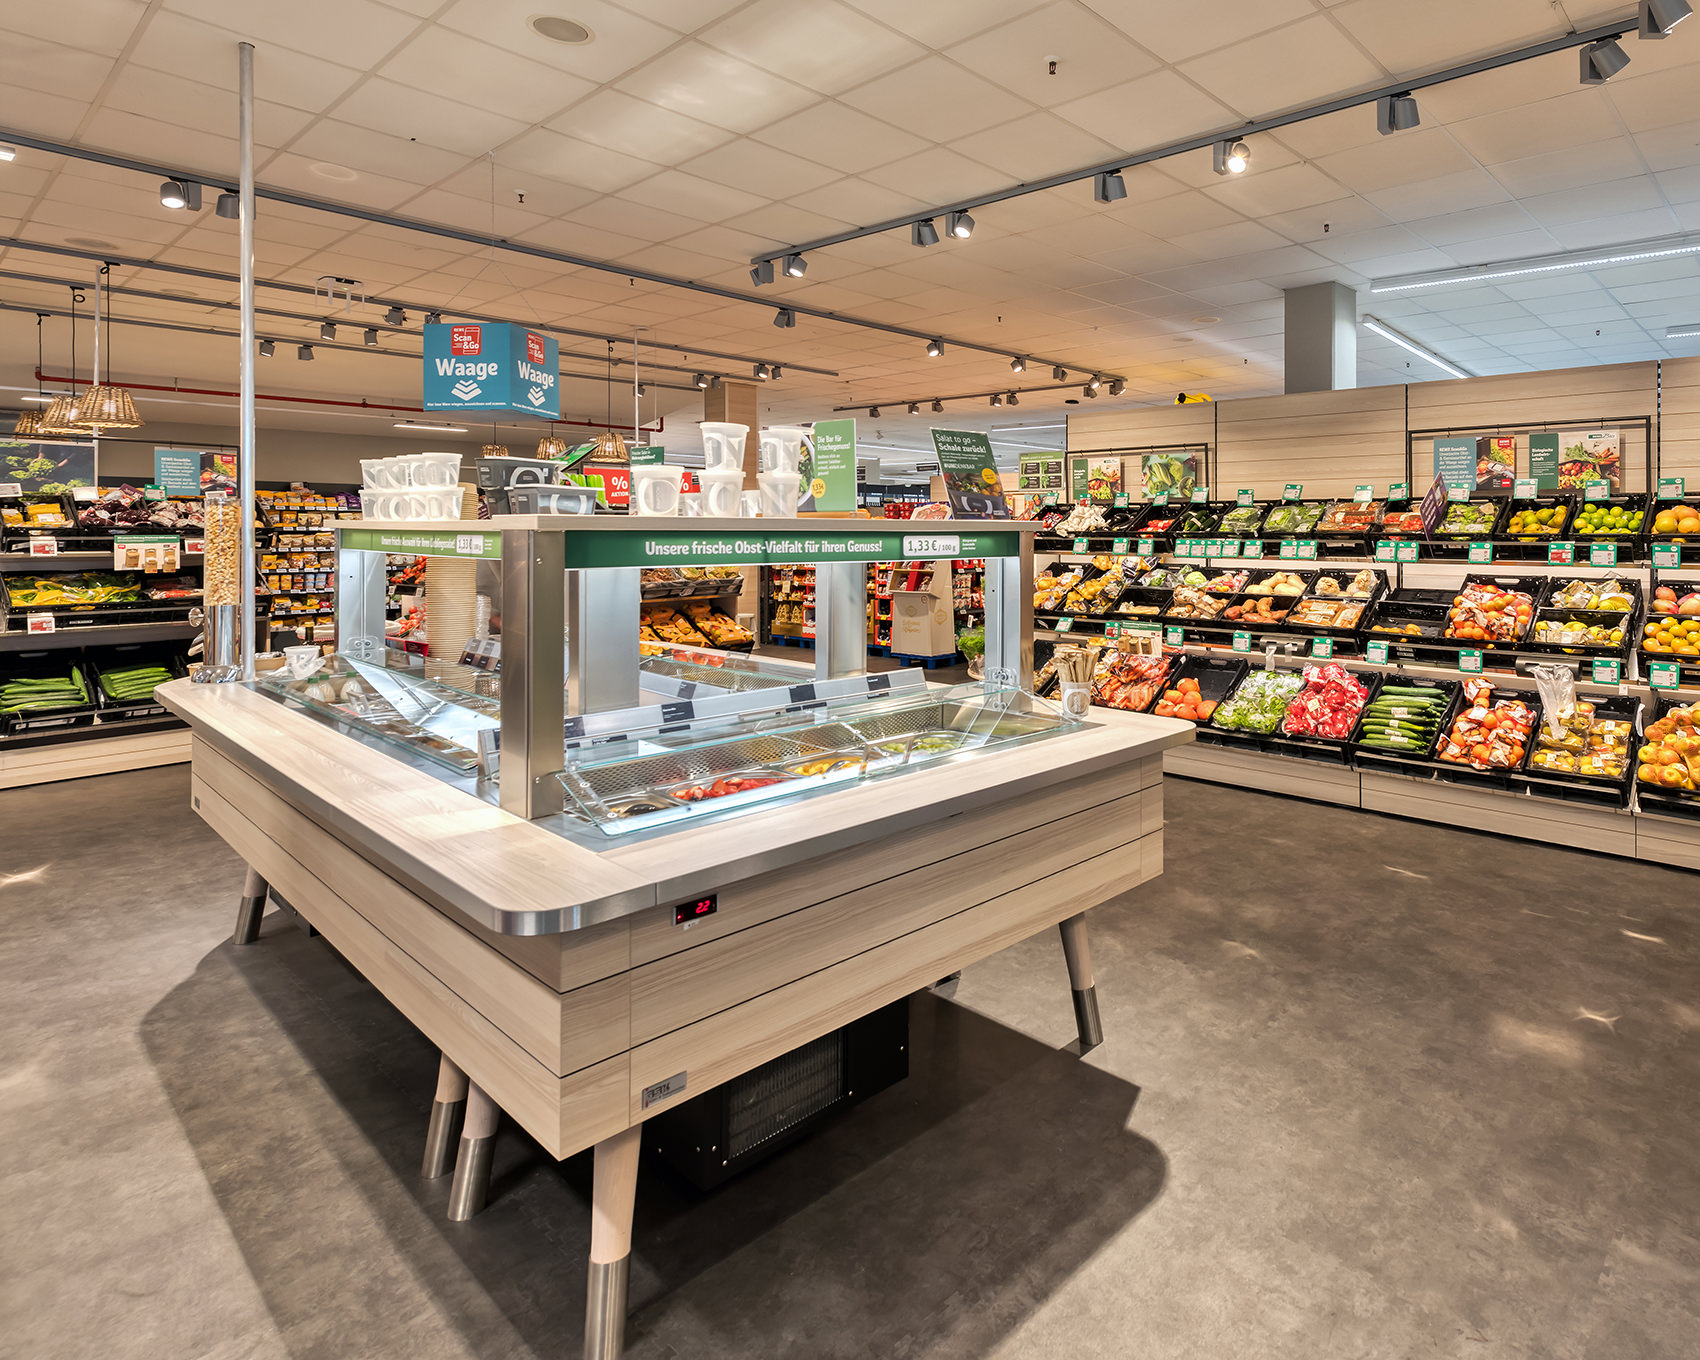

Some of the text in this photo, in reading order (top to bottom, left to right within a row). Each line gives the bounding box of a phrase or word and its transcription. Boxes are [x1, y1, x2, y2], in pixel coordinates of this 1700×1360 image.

[529, 340, 539, 350] Scan
[435, 358, 498, 380] Waage
[518, 360, 555, 390] Waage
[936, 434, 953, 442] Salat
[938, 443, 987, 453] Schale zurück!
[612, 476, 628, 490] %
[645, 540, 883, 556] Unsere frische Obst-Vielfalt für ihren Genuss!
[908, 540, 929, 553] 1,33
[931, 540, 938, 551] €
